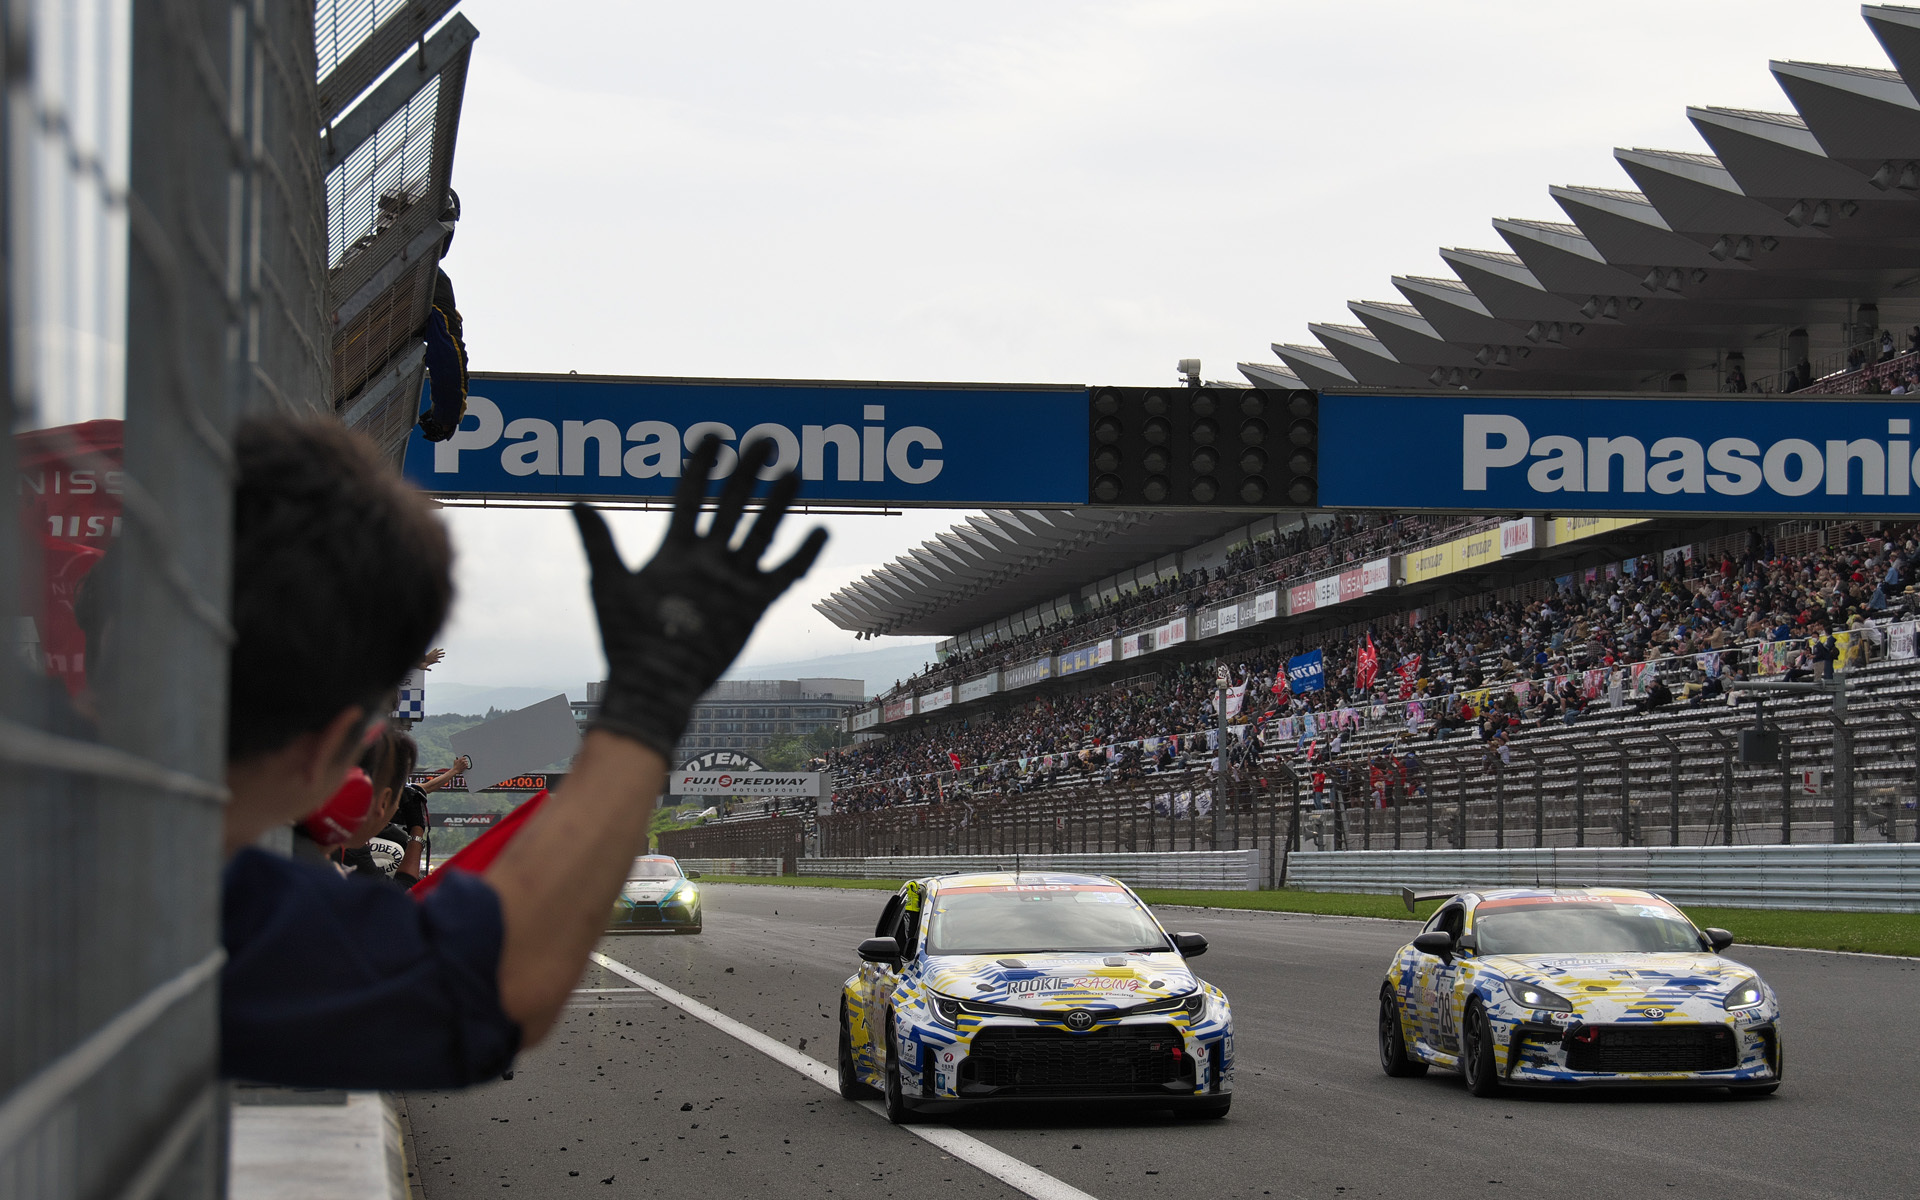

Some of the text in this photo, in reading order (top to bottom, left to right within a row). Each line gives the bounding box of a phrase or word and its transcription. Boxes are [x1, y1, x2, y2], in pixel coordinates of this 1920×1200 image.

[434, 395, 944, 485] Panasonic
[1463, 414, 1920, 497] Panasoni
[17, 470, 125, 495] NISS
[1508, 523, 1529, 547] YAMAHA
[1466, 539, 1492, 558] DUNLOP
[1420, 553, 1443, 571] DUNLOP
[1292, 588, 1315, 608] NISSAN
[1316, 582, 1339, 602] NISSAN
[686, 752, 762, 771] OTENZ
[683, 775, 807, 787] FUJI SPEEDWAY
[370, 843, 393, 855] OBE
[1007, 884, 1072, 892] ENEOS
[1552, 895, 1612, 903] ENEOS
[1006, 976, 1143, 995] ROOKIE RACING
[1438, 991, 1453, 1034] 28
